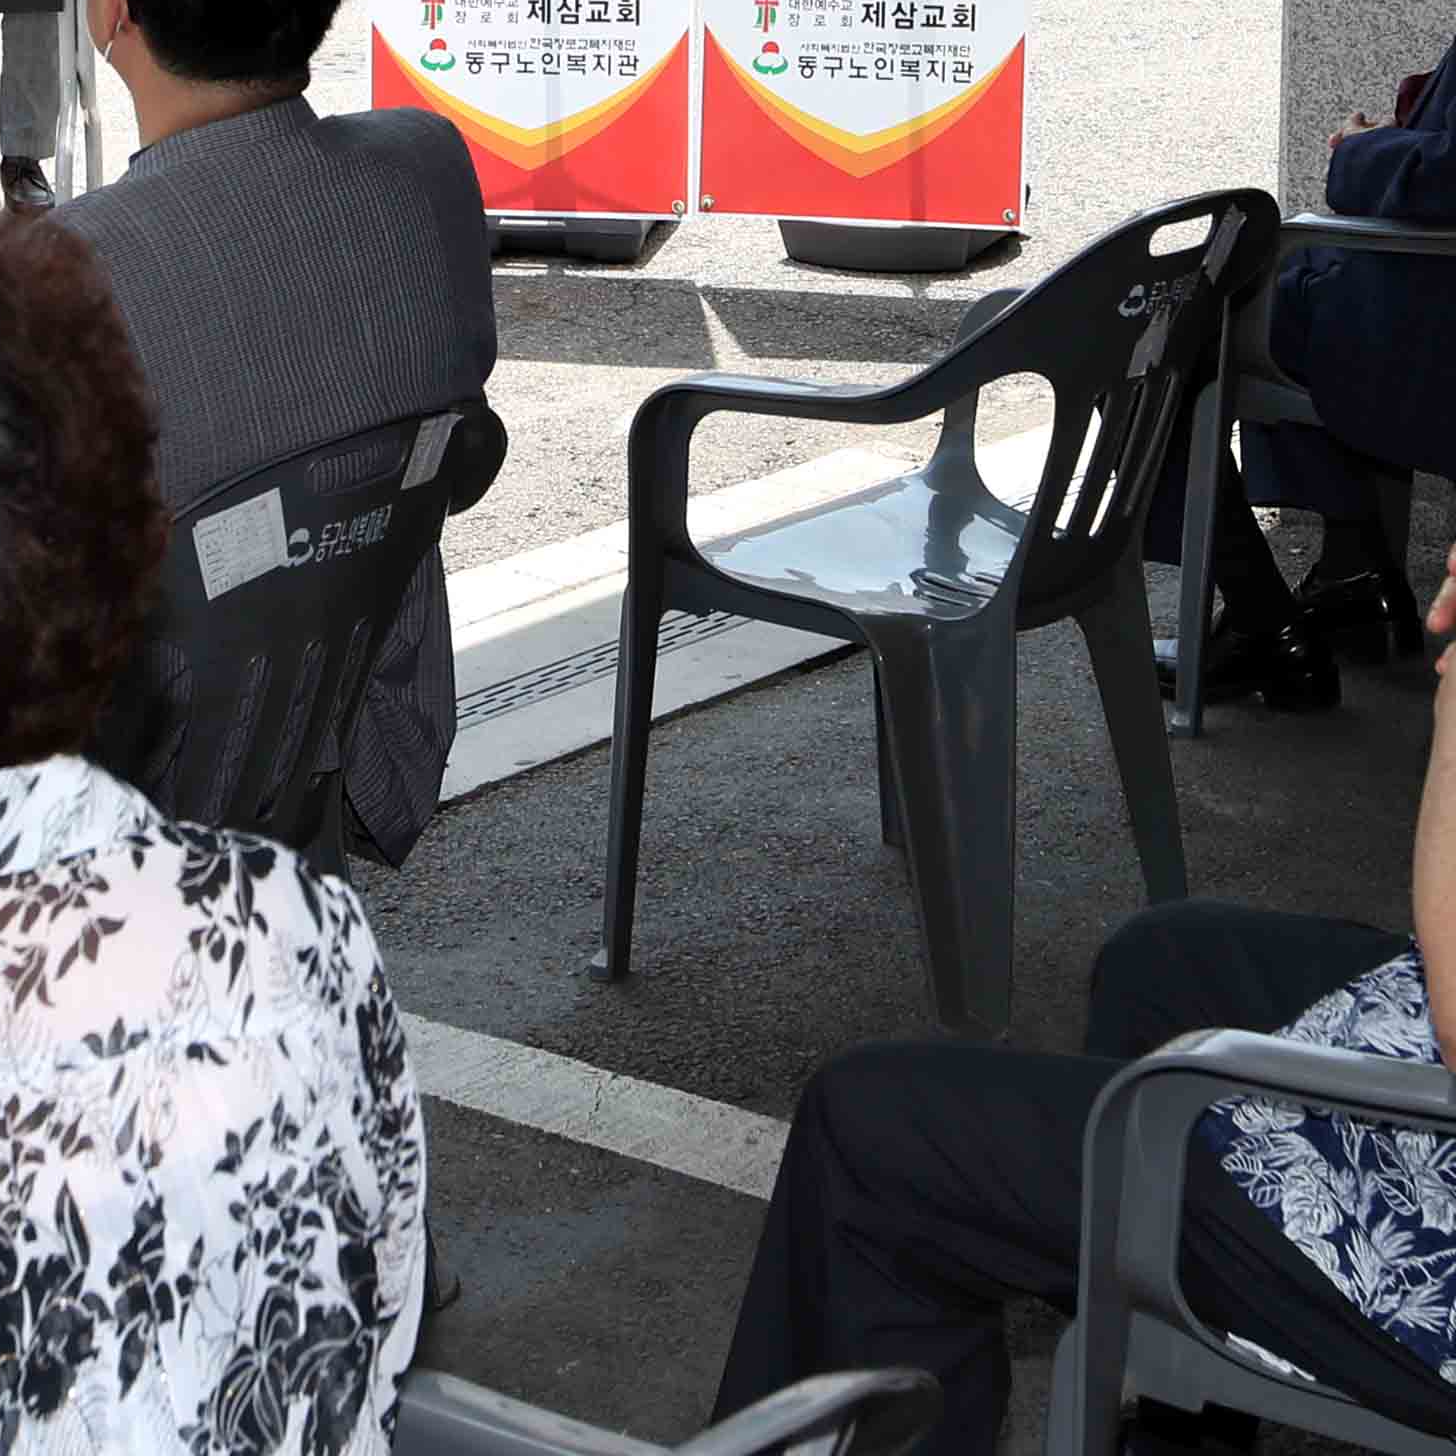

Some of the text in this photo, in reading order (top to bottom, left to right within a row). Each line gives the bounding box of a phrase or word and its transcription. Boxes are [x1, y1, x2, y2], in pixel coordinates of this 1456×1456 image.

[860, 0, 977, 33] 제삼교회
[464, 51, 640, 78] 동구노인복지관
[797, 54, 975, 85] 동구노인복지관
